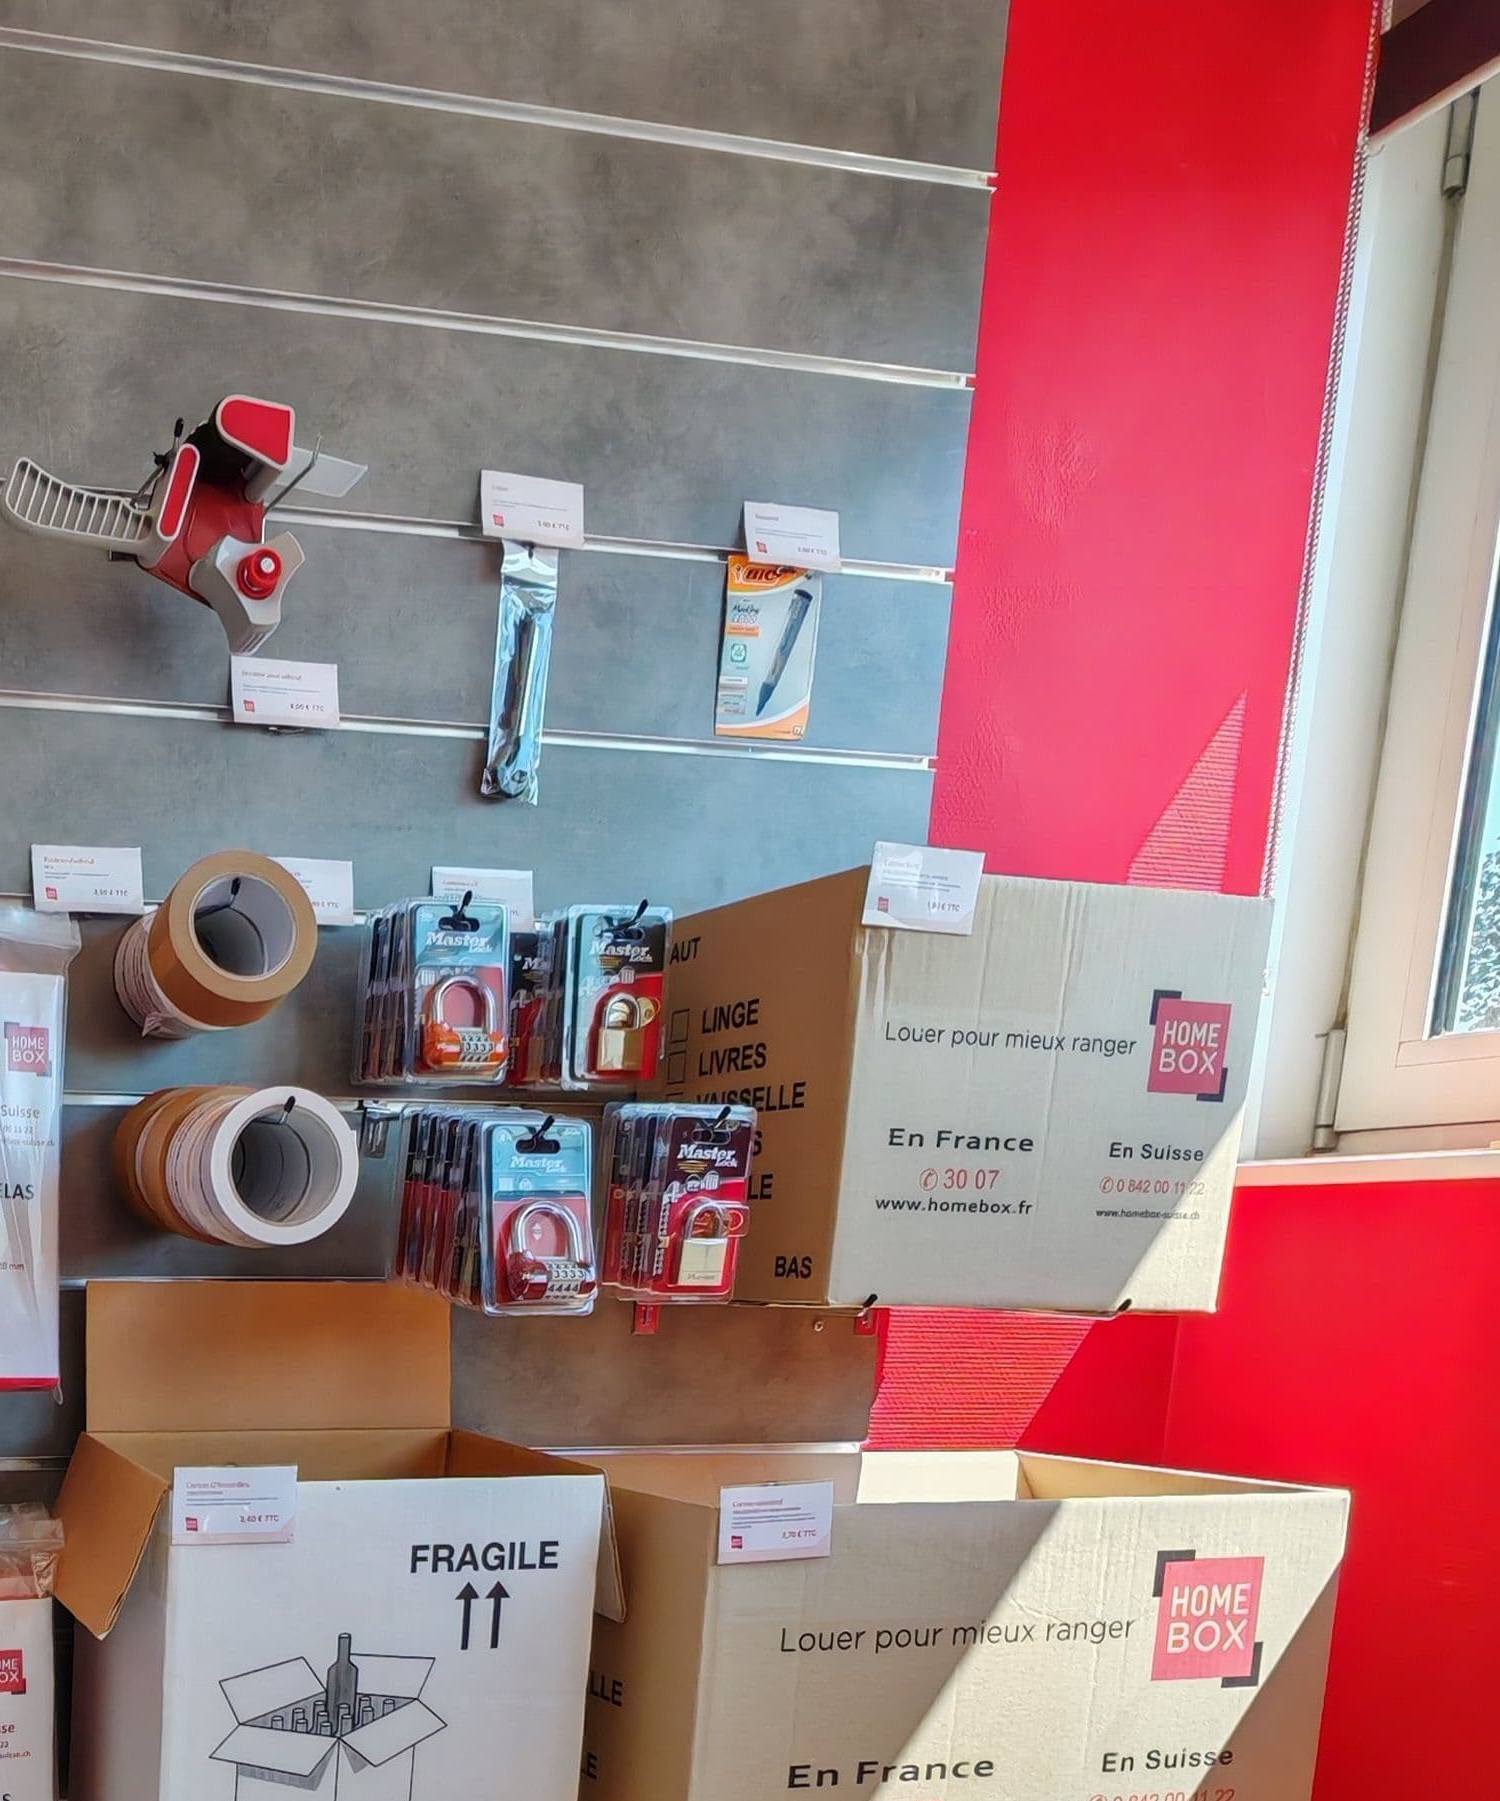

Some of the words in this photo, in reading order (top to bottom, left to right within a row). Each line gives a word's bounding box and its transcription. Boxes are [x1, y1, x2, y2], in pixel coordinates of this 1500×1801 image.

[745, 566, 781, 580] BIC
[426, 932, 490, 946] Master
[590, 940, 649, 955] Master
[670, 937, 700, 964] AUT
[701, 999, 760, 1034] LINGE
[12, 1036, 44, 1049] HOME
[885, 1022, 945, 1043] Louer
[951, 1027, 1000, 1048] pour
[1005, 1031, 1064, 1051] mieux
[1072, 1035, 1138, 1056] ranger
[1162, 1020, 1221, 1048] HOME
[12, 1050, 46, 1064] BOX
[699, 1043, 767, 1076] LIVRES
[1159, 1049, 1218, 1075] BOX
[2, 1105, 40, 1119] Suisse
[888, 1128, 924, 1148] En
[936, 1130, 1034, 1152] France
[1109, 1142, 1133, 1159] En
[1141, 1144, 1204, 1161] Suisse
[510, 1156, 563, 1168] Master
[677, 1144, 735, 1160] Master
[715, 1158, 738, 1167] Lock
[943, 1169, 968, 1189] 30
[975, 1170, 999, 1190] 07
[1128, 1179, 1149, 1193] 842
[1154, 1181, 1169, 1194] 00
[876, 1197, 1032, 1215] www.homebox.fr
[774, 1256, 812, 1279] BAS
[410, 1541, 559, 1574] FRAGILE
[1171, 1583, 1251, 1618] HOME
[780, 1626, 865, 1653] Louer
[875, 1625, 942, 1654] pour
[952, 1619, 1034, 1646] mieux
[1046, 1618, 1135, 1646] ranger
[1167, 1619, 1248, 1654] BOX
[1101, 1752, 1134, 1772] En
[1146, 1748, 1233, 1770] Suisse
[788, 1764, 839, 1789] En
[856, 1759, 994, 1785] France
